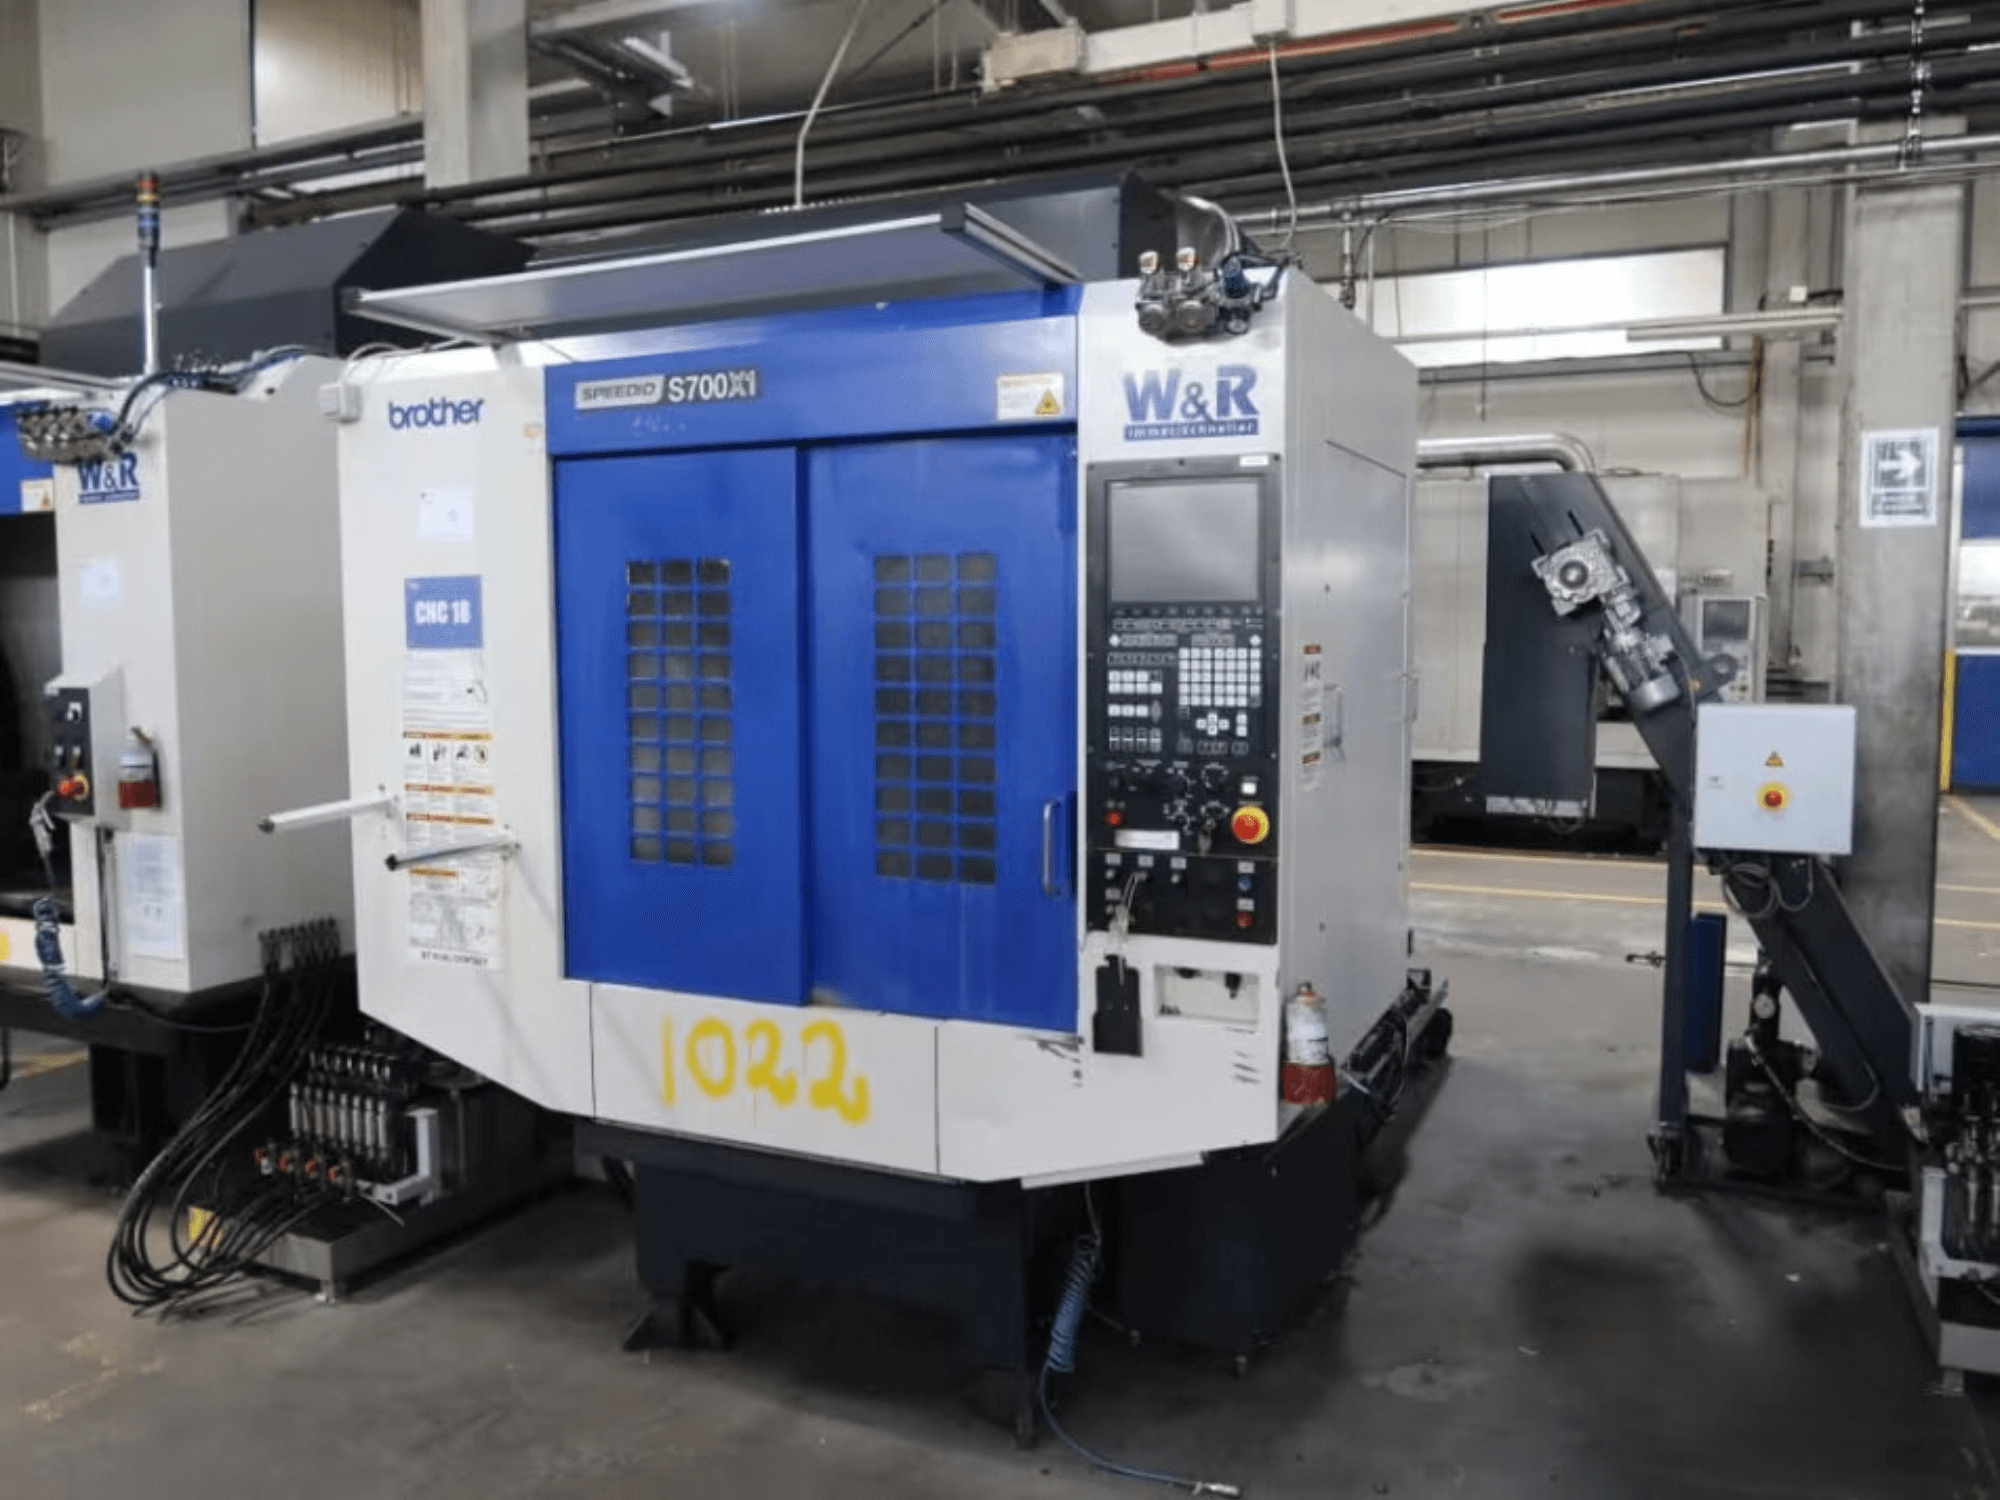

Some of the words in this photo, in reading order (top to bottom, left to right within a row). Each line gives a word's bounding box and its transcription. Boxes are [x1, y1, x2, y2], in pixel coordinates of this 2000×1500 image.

[582, 381, 657, 401] SPEEDIO
[1123, 364, 1259, 422] W&R
[389, 397, 484, 429] brother
[78, 452, 139, 490] W&R
[415, 600, 448, 624] CNC
[660, 1014, 874, 1128] 1022
